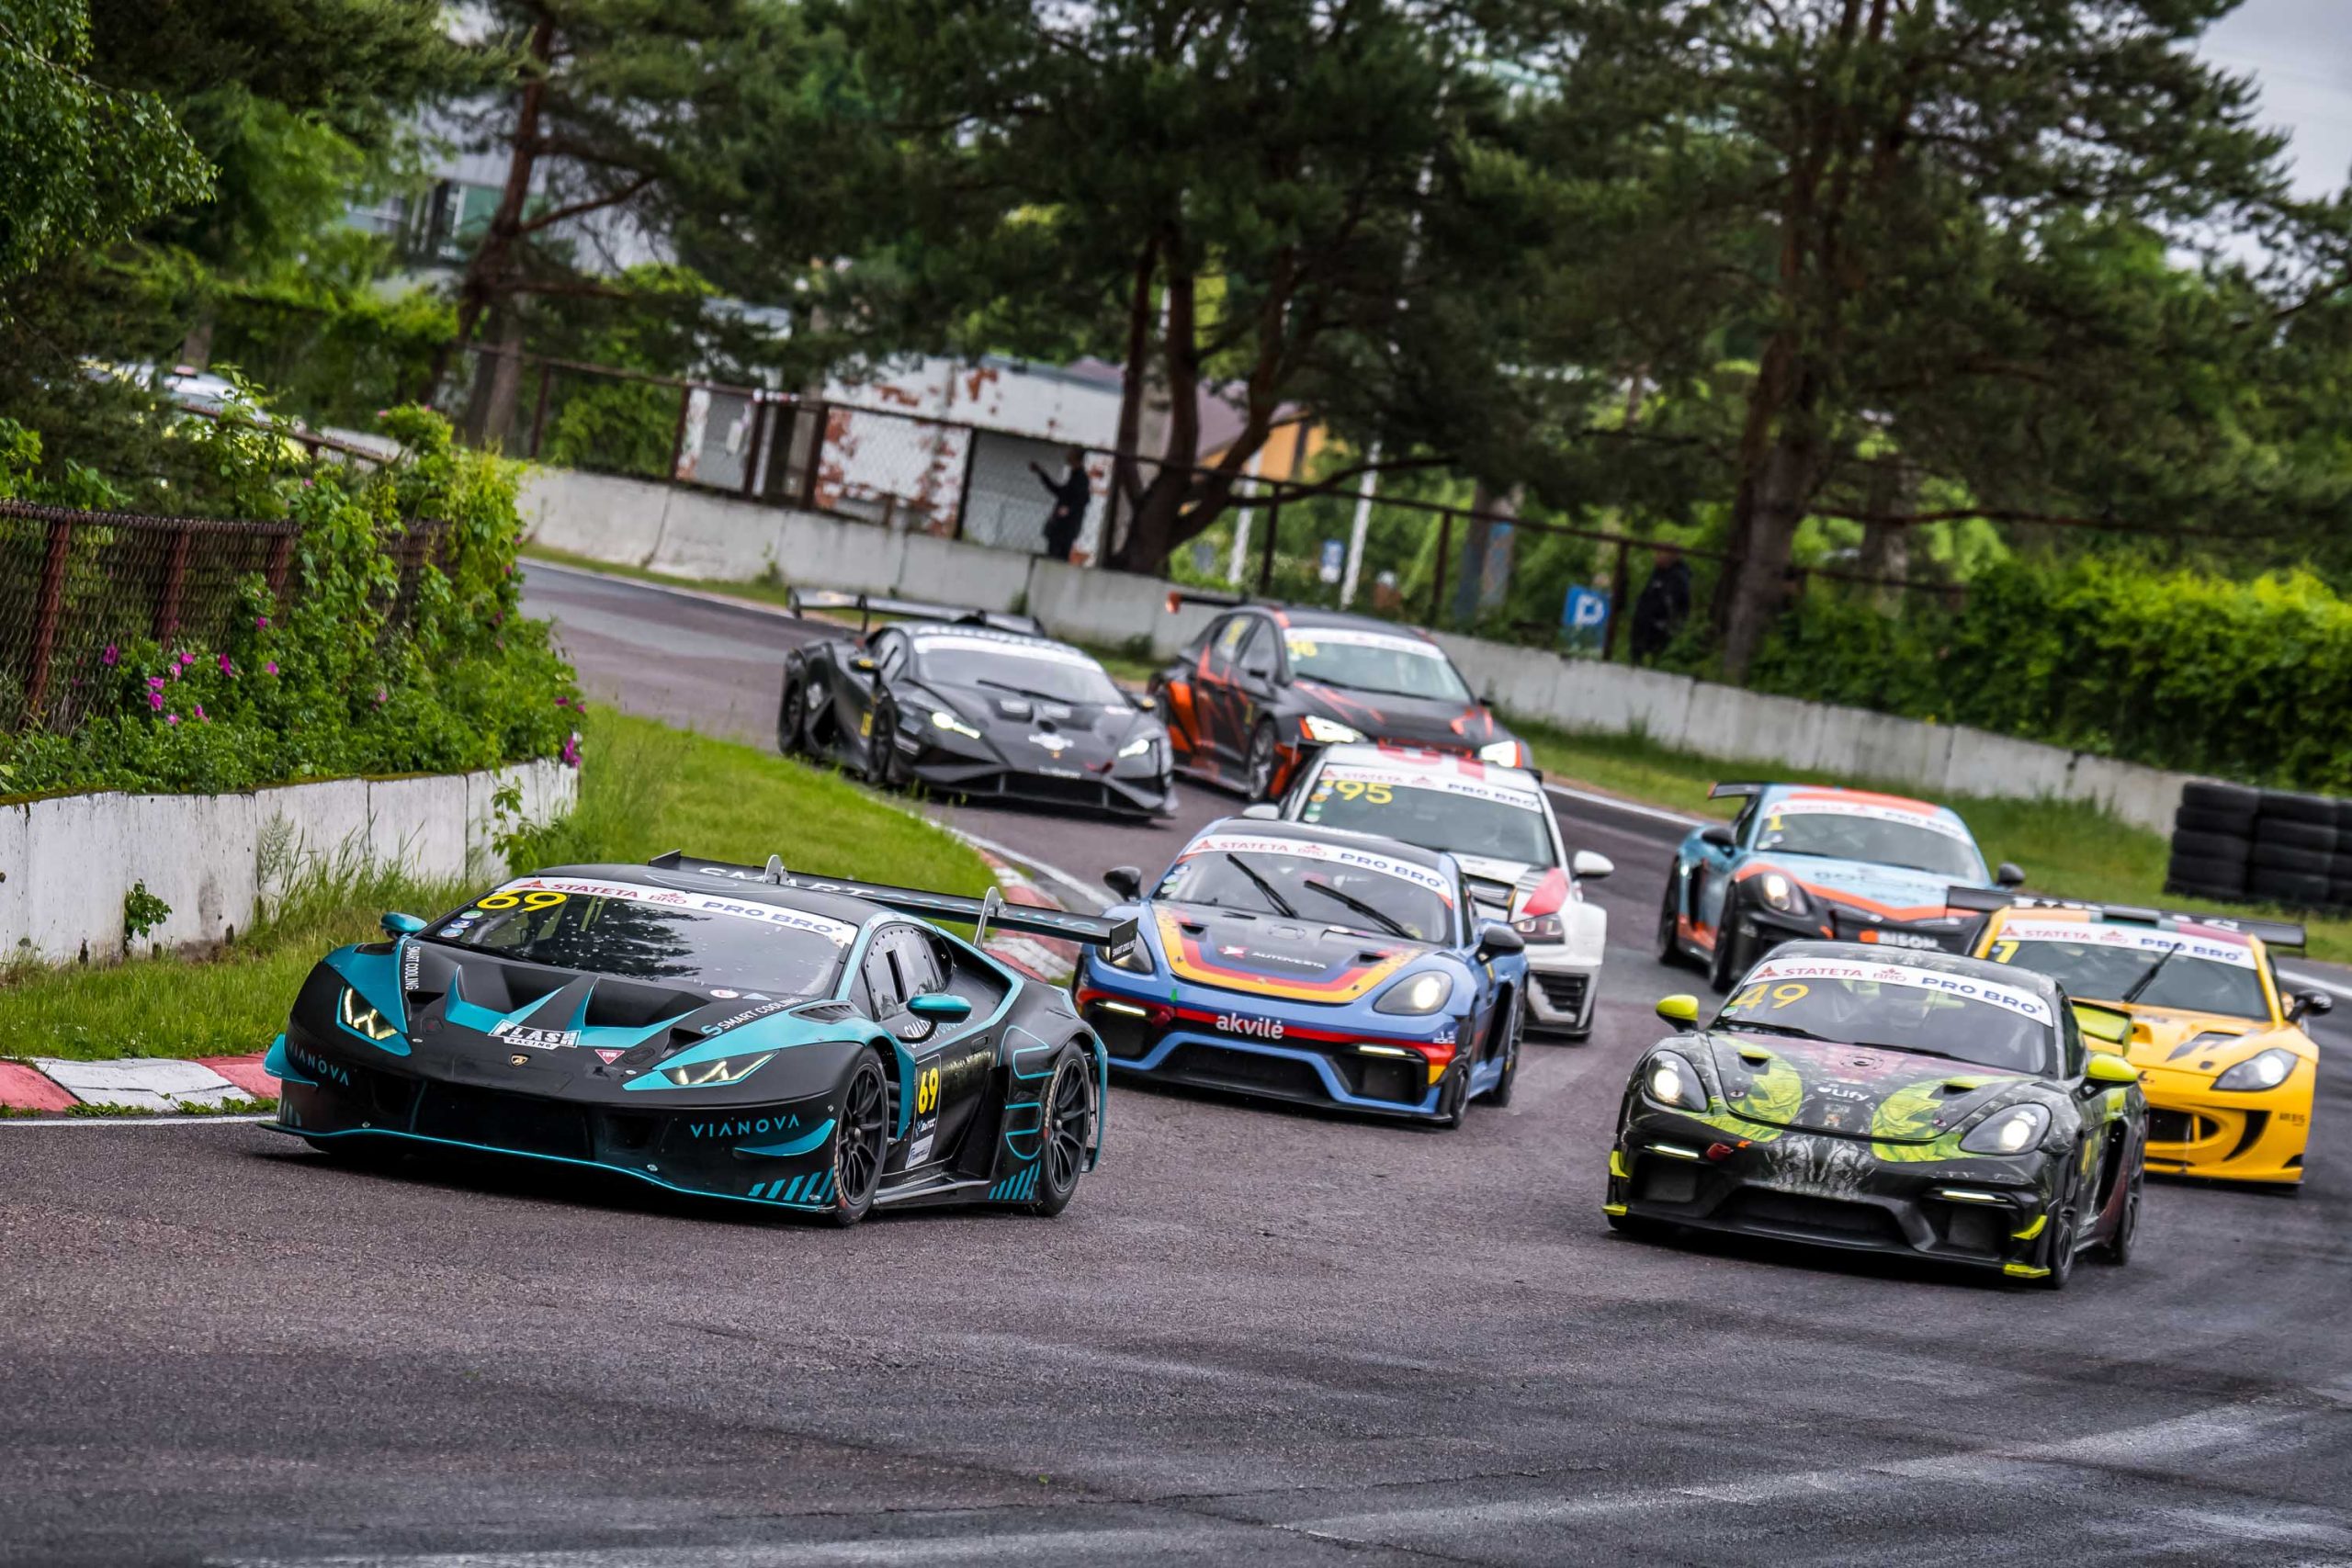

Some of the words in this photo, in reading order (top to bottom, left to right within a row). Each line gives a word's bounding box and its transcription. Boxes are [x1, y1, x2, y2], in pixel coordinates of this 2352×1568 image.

[1574, 594, 1605, 631] P
[1219, 841, 1288, 852] STATETA
[1340, 852, 1387, 869] PRO
[1394, 865, 1442, 887] BRO
[476, 890, 568, 912] 69
[551, 884, 638, 897] STATETA
[649, 895, 686, 905] BRO
[702, 901, 764, 917] PRO
[770, 913, 832, 933] BRO
[2025, 930, 2091, 940] STATETA
[2141, 938, 2186, 951] PRO
[2193, 946, 2238, 961] BRO
[1783, 966, 1862, 977] STATETA
[1730, 983, 1809, 1010] 49
[1922, 977, 1976, 994] PRO
[1984, 990, 2037, 1014] BRO
[717, 1010, 758, 1030] SMART
[754, 998, 803, 1015] COOLING
[1216, 1012, 1284, 1040] akvilė
[493, 1022, 579, 1046] FLASH
[509, 1039, 551, 1048] RACING
[289, 1042, 349, 1086] VIANOVA
[918, 1067, 939, 1114] 69
[690, 1113, 799, 1138] VIANOVA
